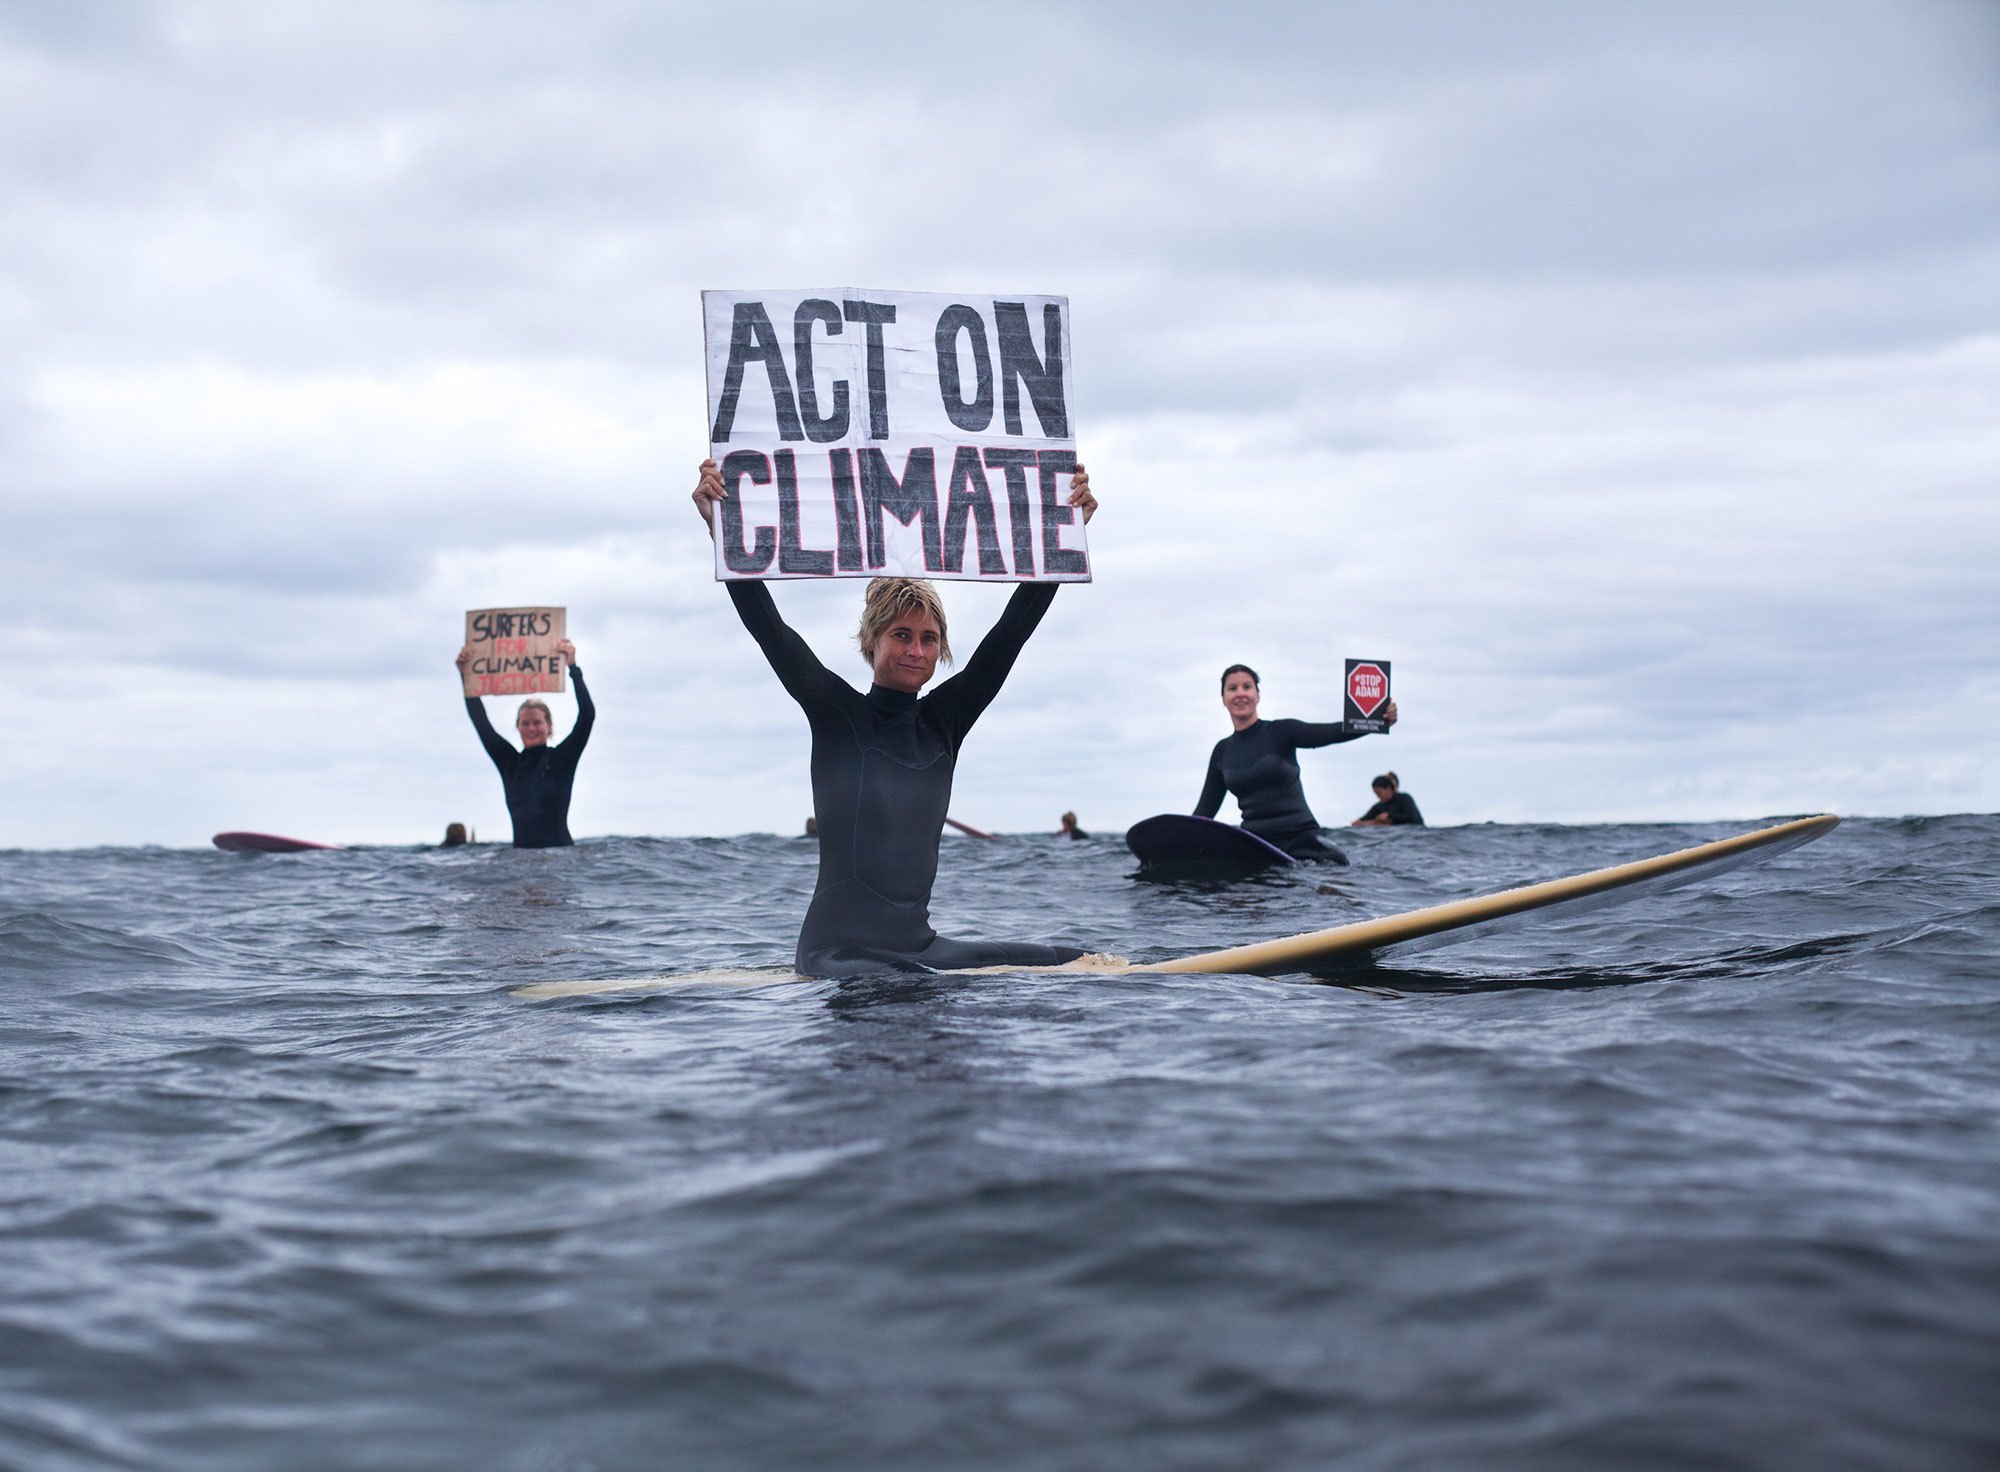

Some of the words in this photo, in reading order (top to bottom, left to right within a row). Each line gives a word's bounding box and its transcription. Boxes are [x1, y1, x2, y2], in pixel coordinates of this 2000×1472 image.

[711, 298, 896, 443] ACT
[935, 300, 1069, 439] ON
[720, 445, 1088, 577] CLIMATE
[472, 612, 552, 643] SURFERS
[495, 637, 528, 656] FOR
[471, 655, 561, 674] CLIMATE
[473, 672, 549, 696] JUSTICE
[1354, 673, 1382, 688] #STOP
[1355, 685, 1381, 699] ADANI
